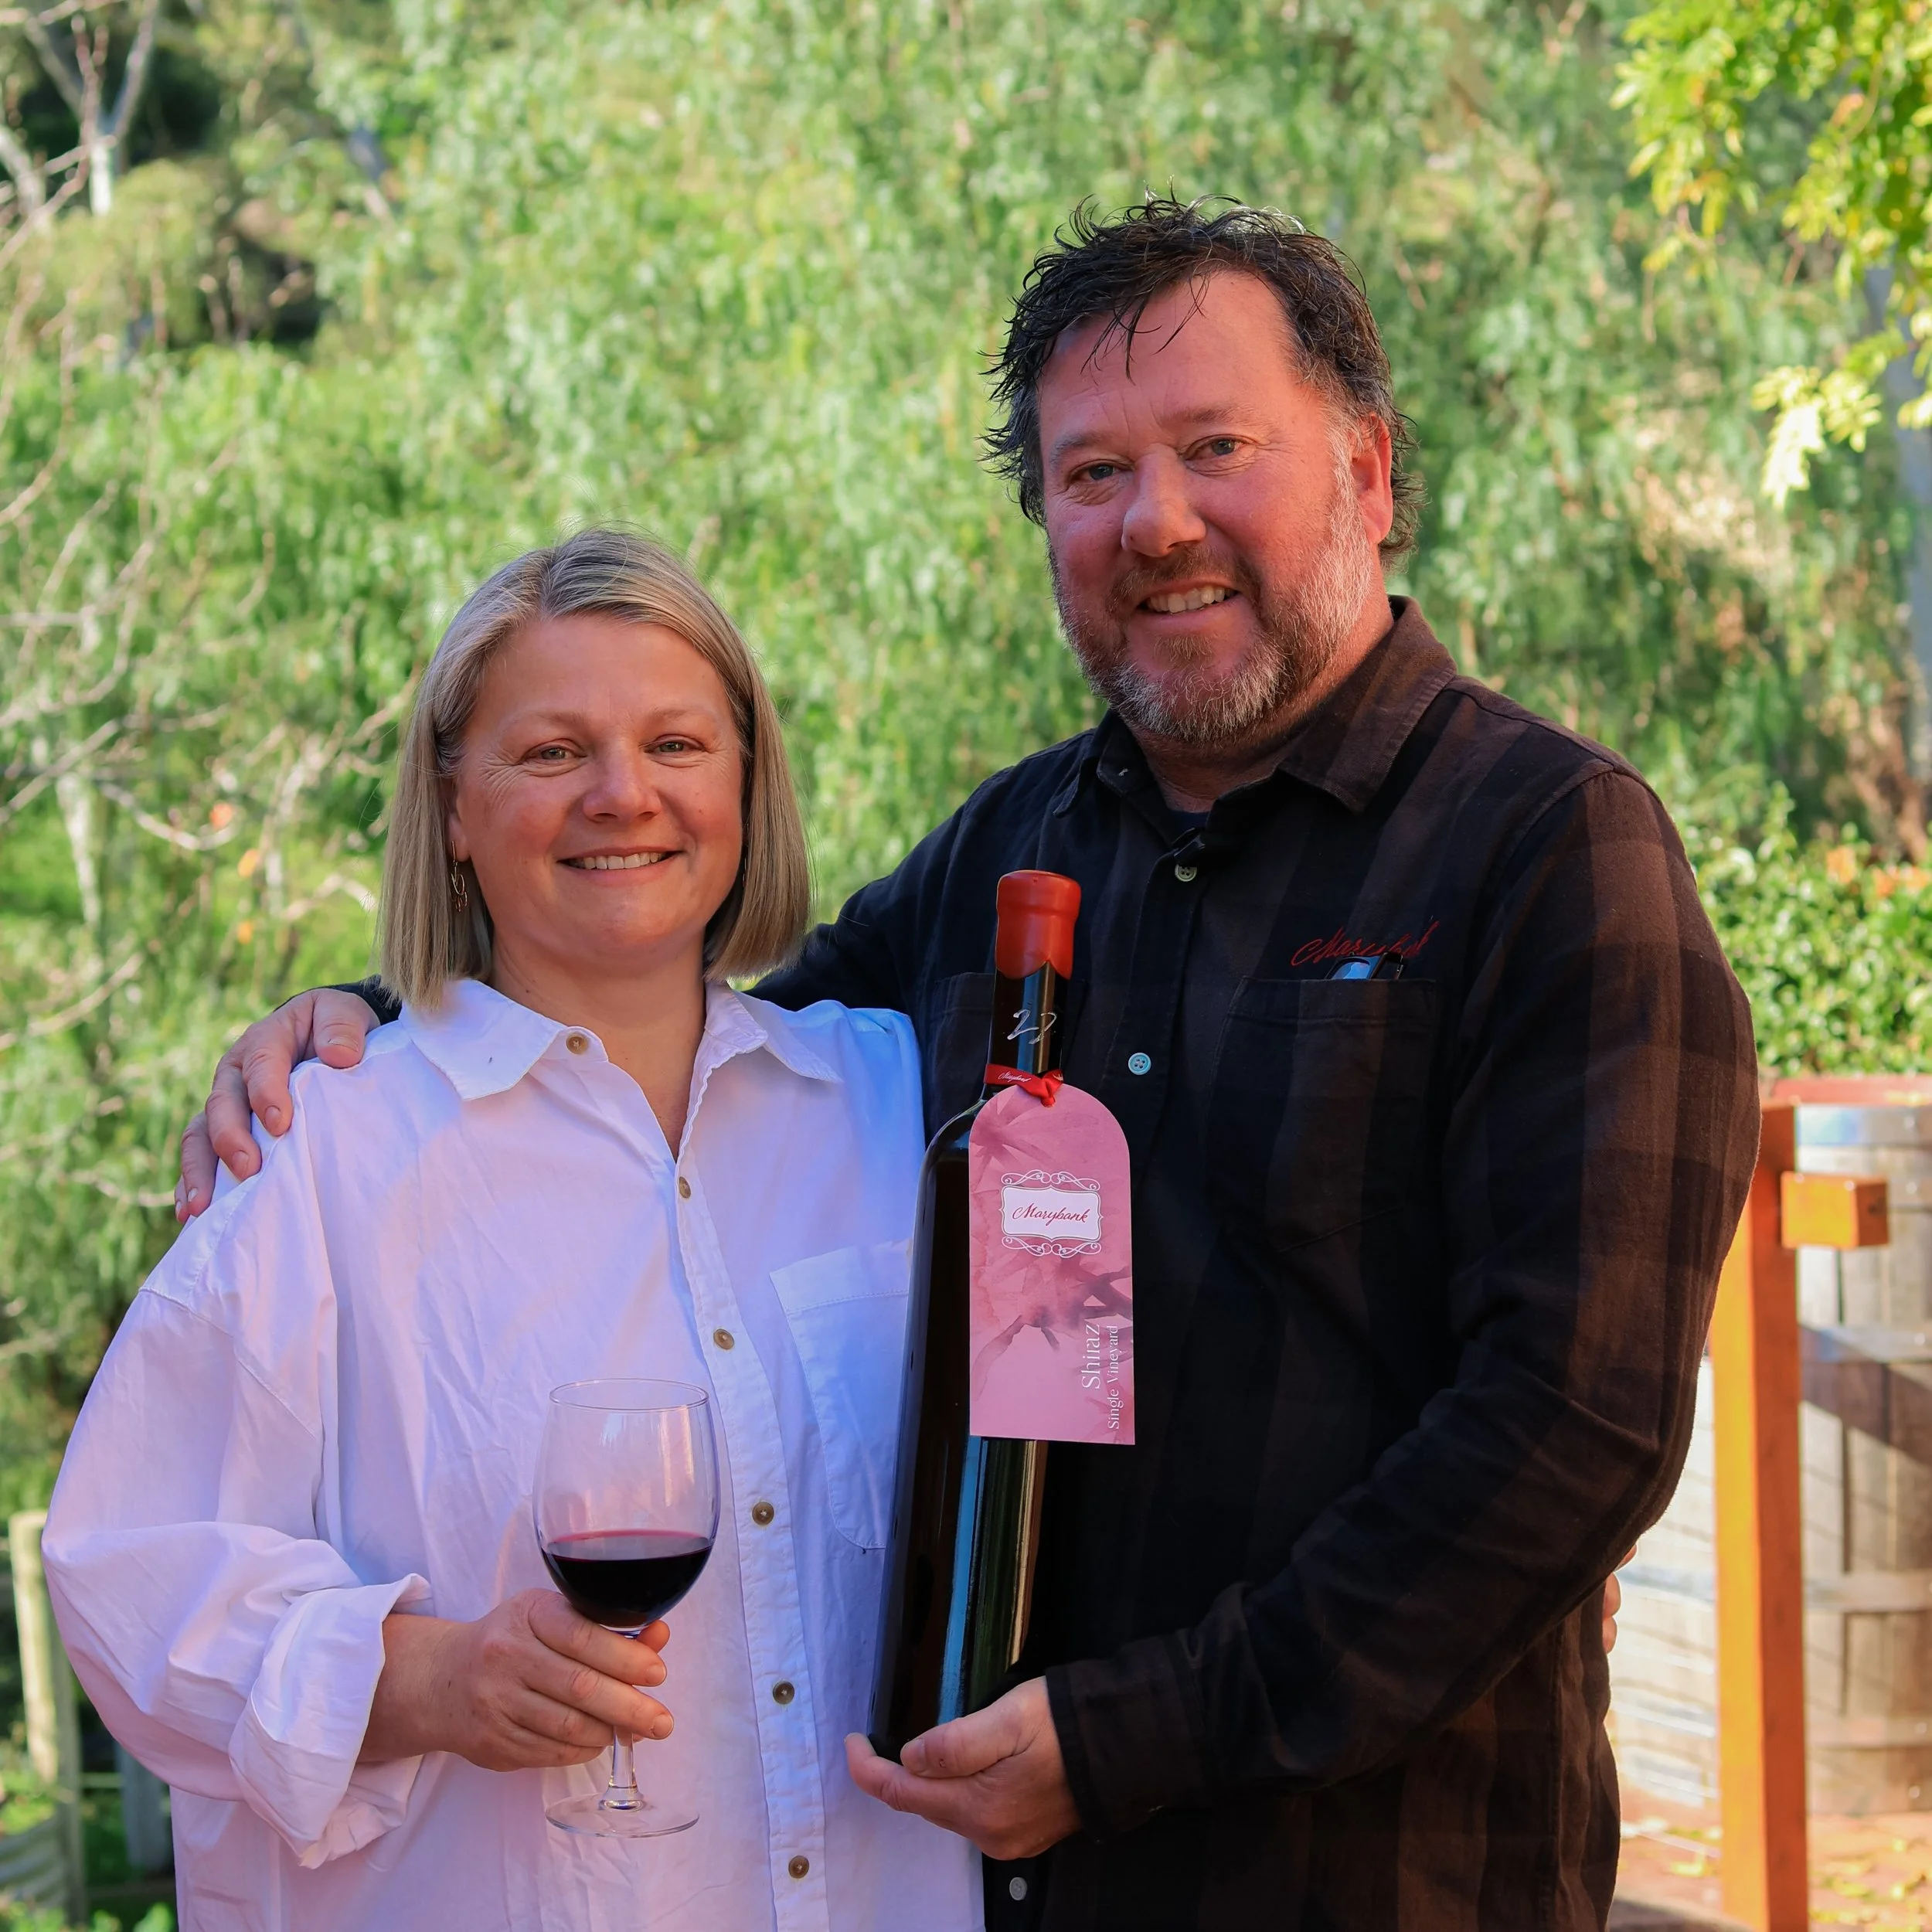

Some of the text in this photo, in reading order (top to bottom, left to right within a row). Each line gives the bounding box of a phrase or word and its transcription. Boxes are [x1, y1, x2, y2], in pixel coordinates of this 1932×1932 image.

[1012, 1202, 1090, 1226] Marybank
[1081, 1324, 1101, 1389] Shiraz
[1107, 1325, 1124, 1430] Single Vineyard
